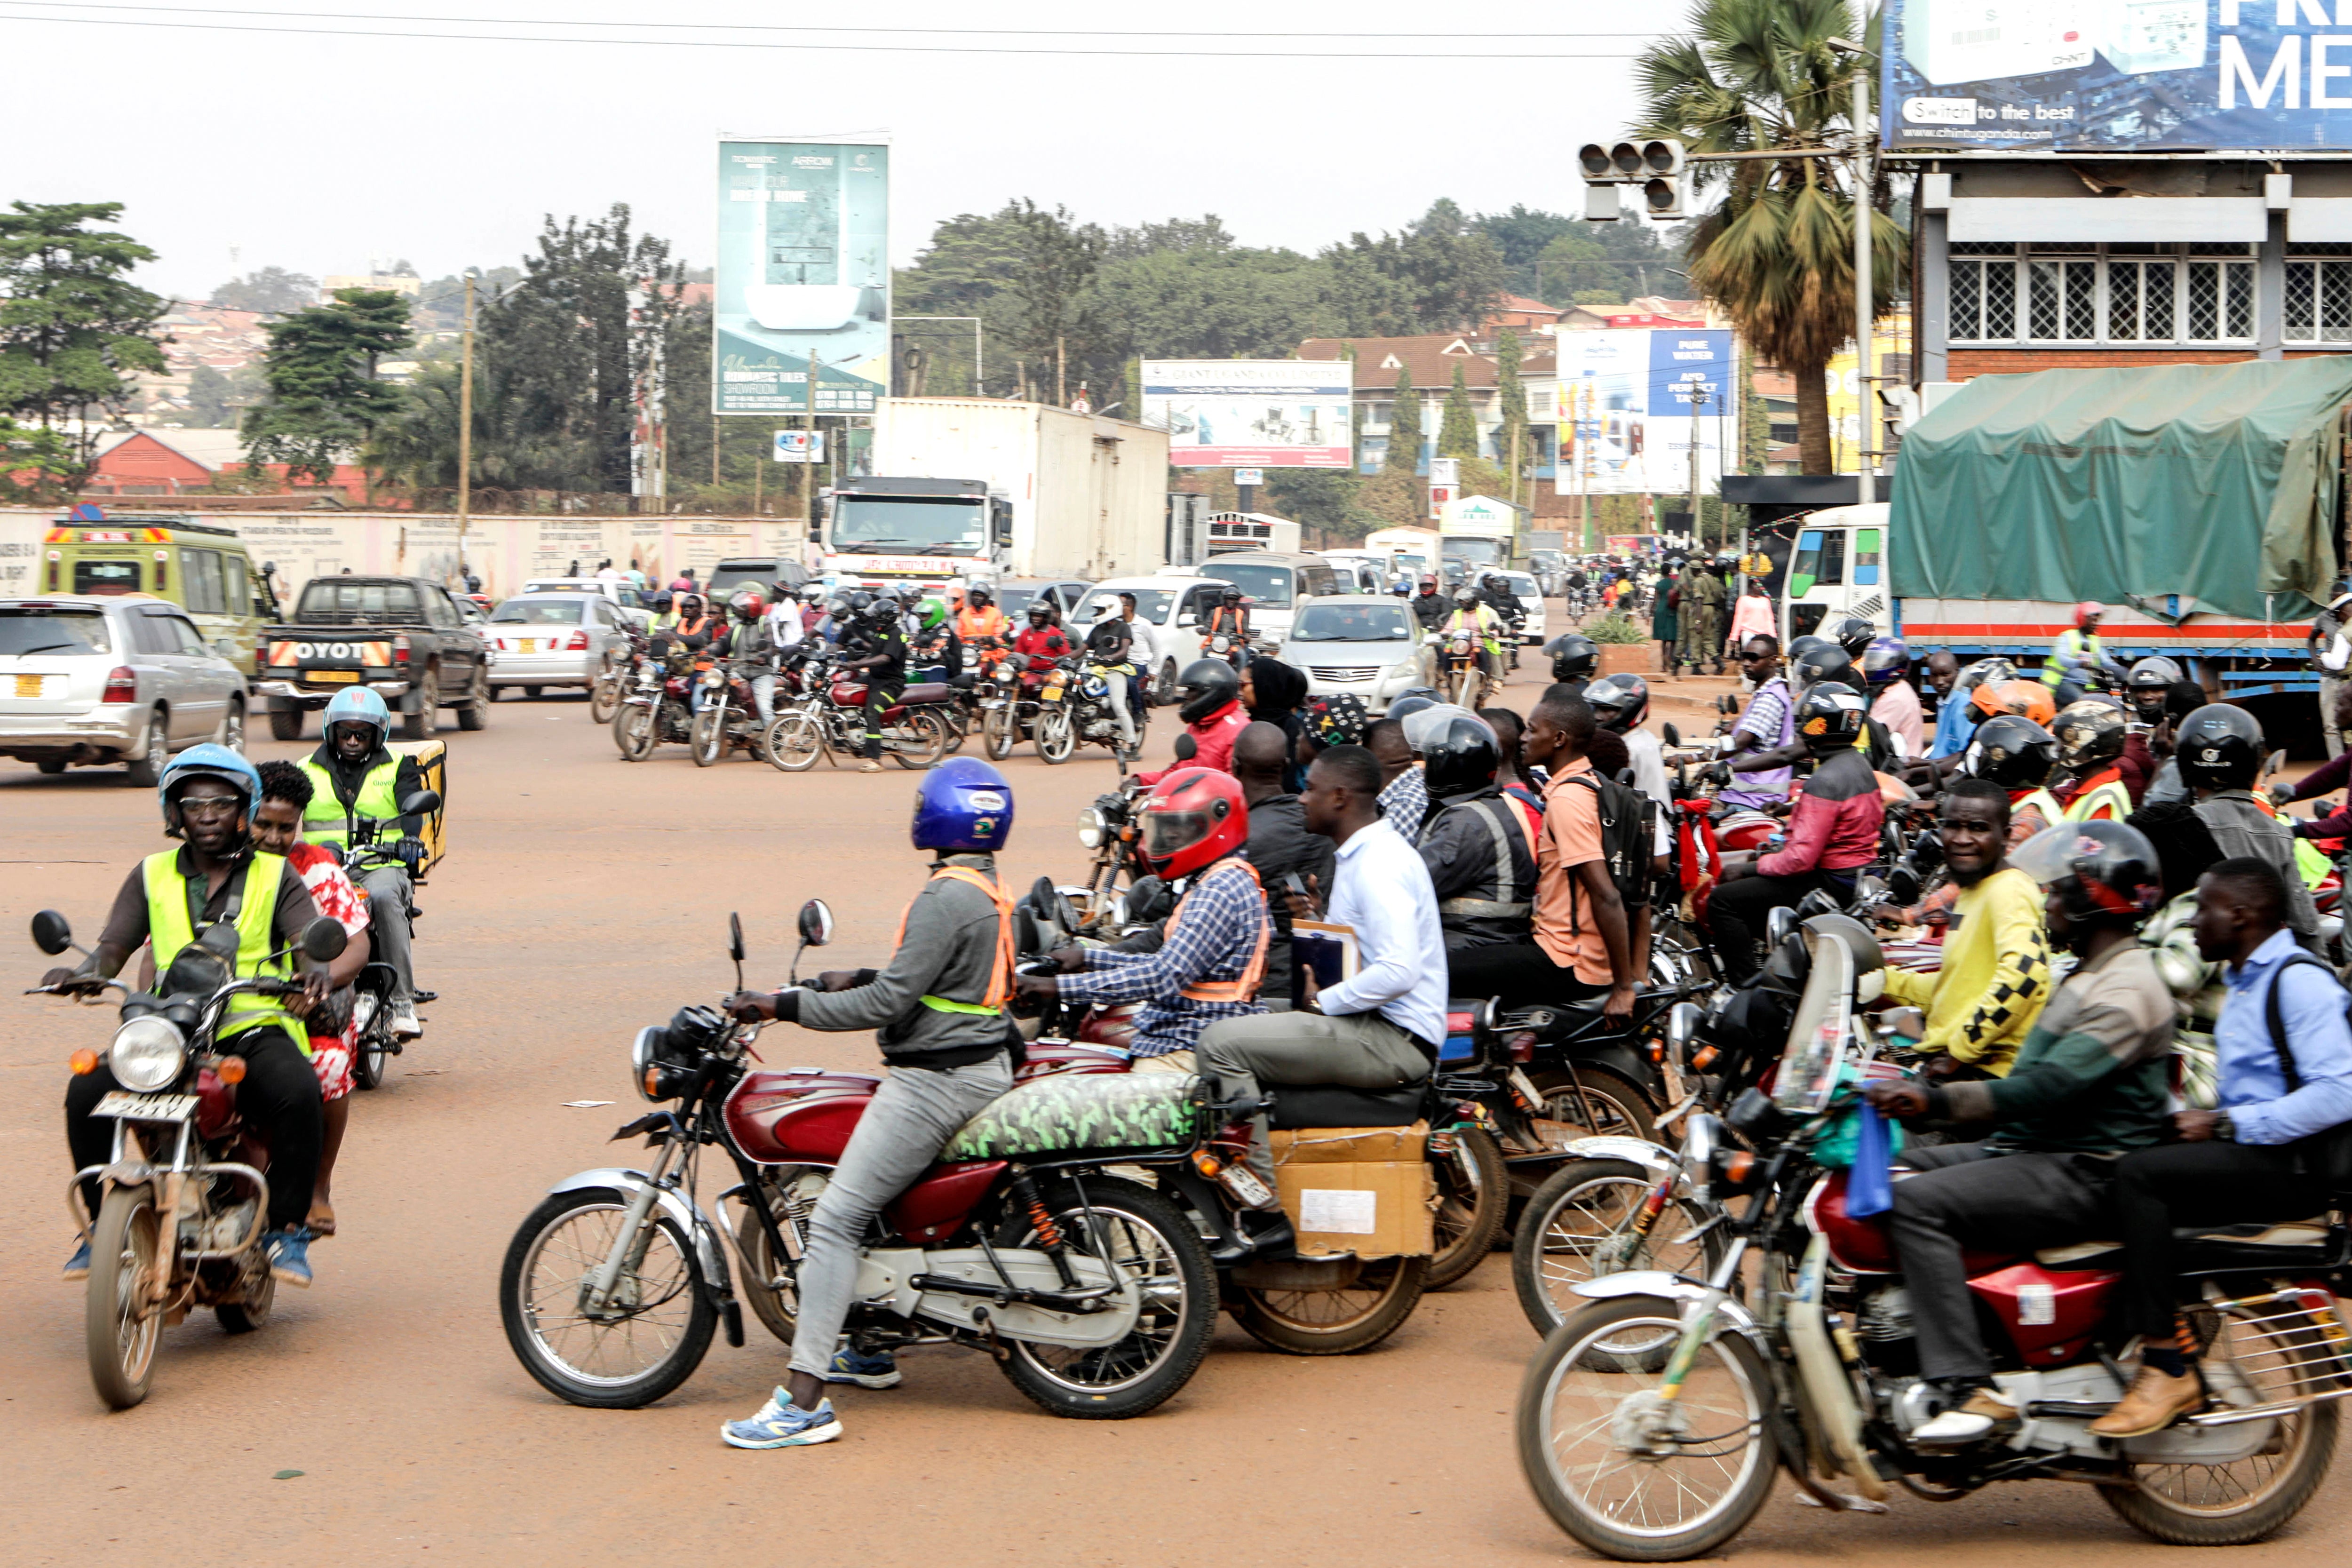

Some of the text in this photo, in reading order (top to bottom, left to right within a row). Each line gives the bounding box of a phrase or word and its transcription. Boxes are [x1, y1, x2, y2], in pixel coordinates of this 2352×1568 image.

[1914, 102, 2075, 120] Switch to the best
[1678, 340, 1708, 350] PURE
[1672, 351, 1714, 360] WATER
[779, 372, 808, 383] TILES
[723, 383, 778, 394] SHOWROOM
